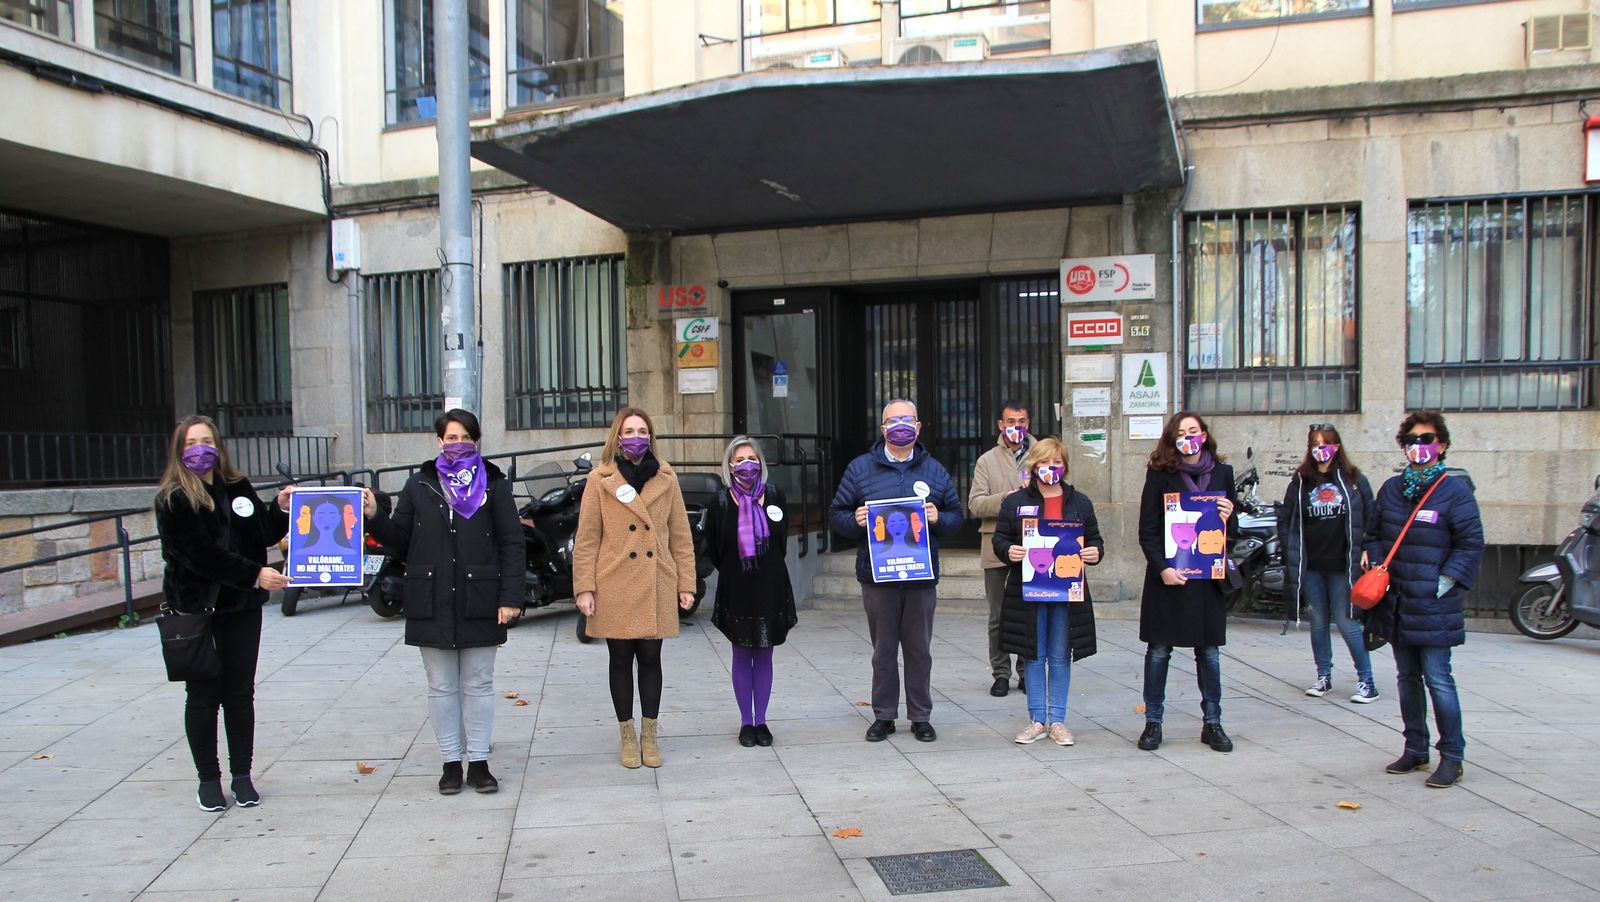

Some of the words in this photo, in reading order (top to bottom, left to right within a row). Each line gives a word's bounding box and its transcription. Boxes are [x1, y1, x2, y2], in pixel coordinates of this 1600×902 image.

[1071, 270, 1092, 281] UGT
[1098, 269, 1116, 279] FSP
[659, 285, 706, 307] USO
[1073, 322, 1118, 334] CCOO
[1129, 391, 1160, 399] ASAJA
[317, 564, 355, 572] MALTRATES
[895, 562, 926, 571] MALTRATES
